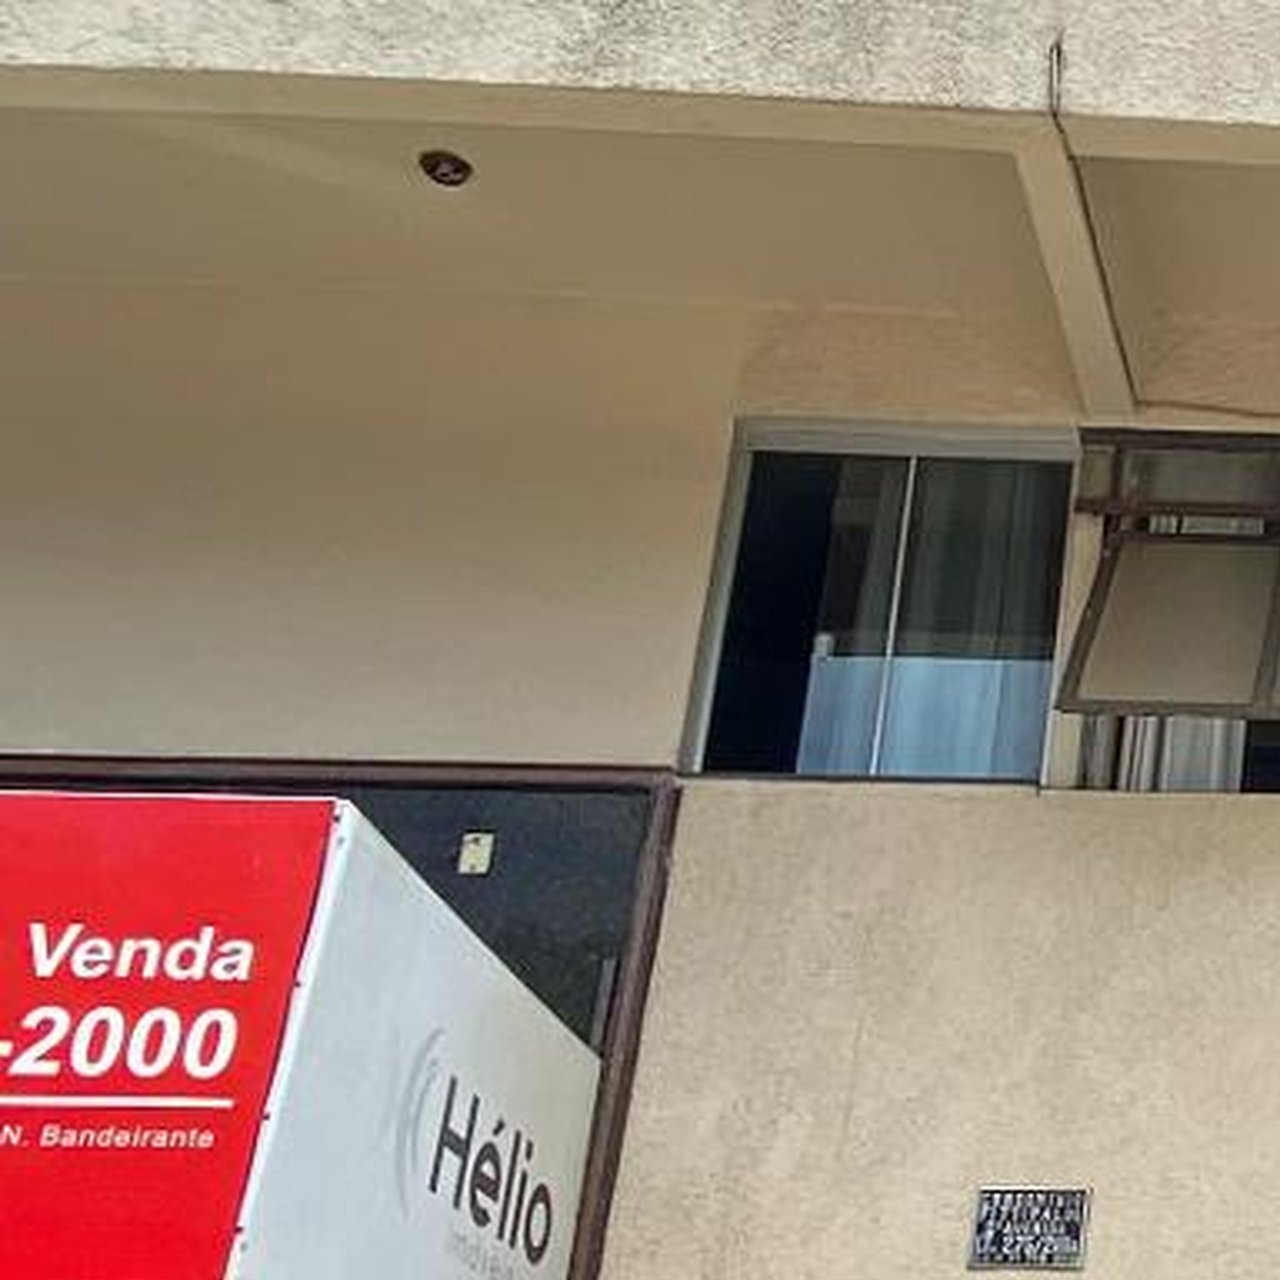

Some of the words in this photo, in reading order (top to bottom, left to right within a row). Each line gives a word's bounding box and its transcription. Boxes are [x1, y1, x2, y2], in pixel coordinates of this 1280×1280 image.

[27, 923, 256, 981] Venda
[39, 1122, 215, 1148] Bandeirante
[428, 1075, 552, 1266] Hélio
